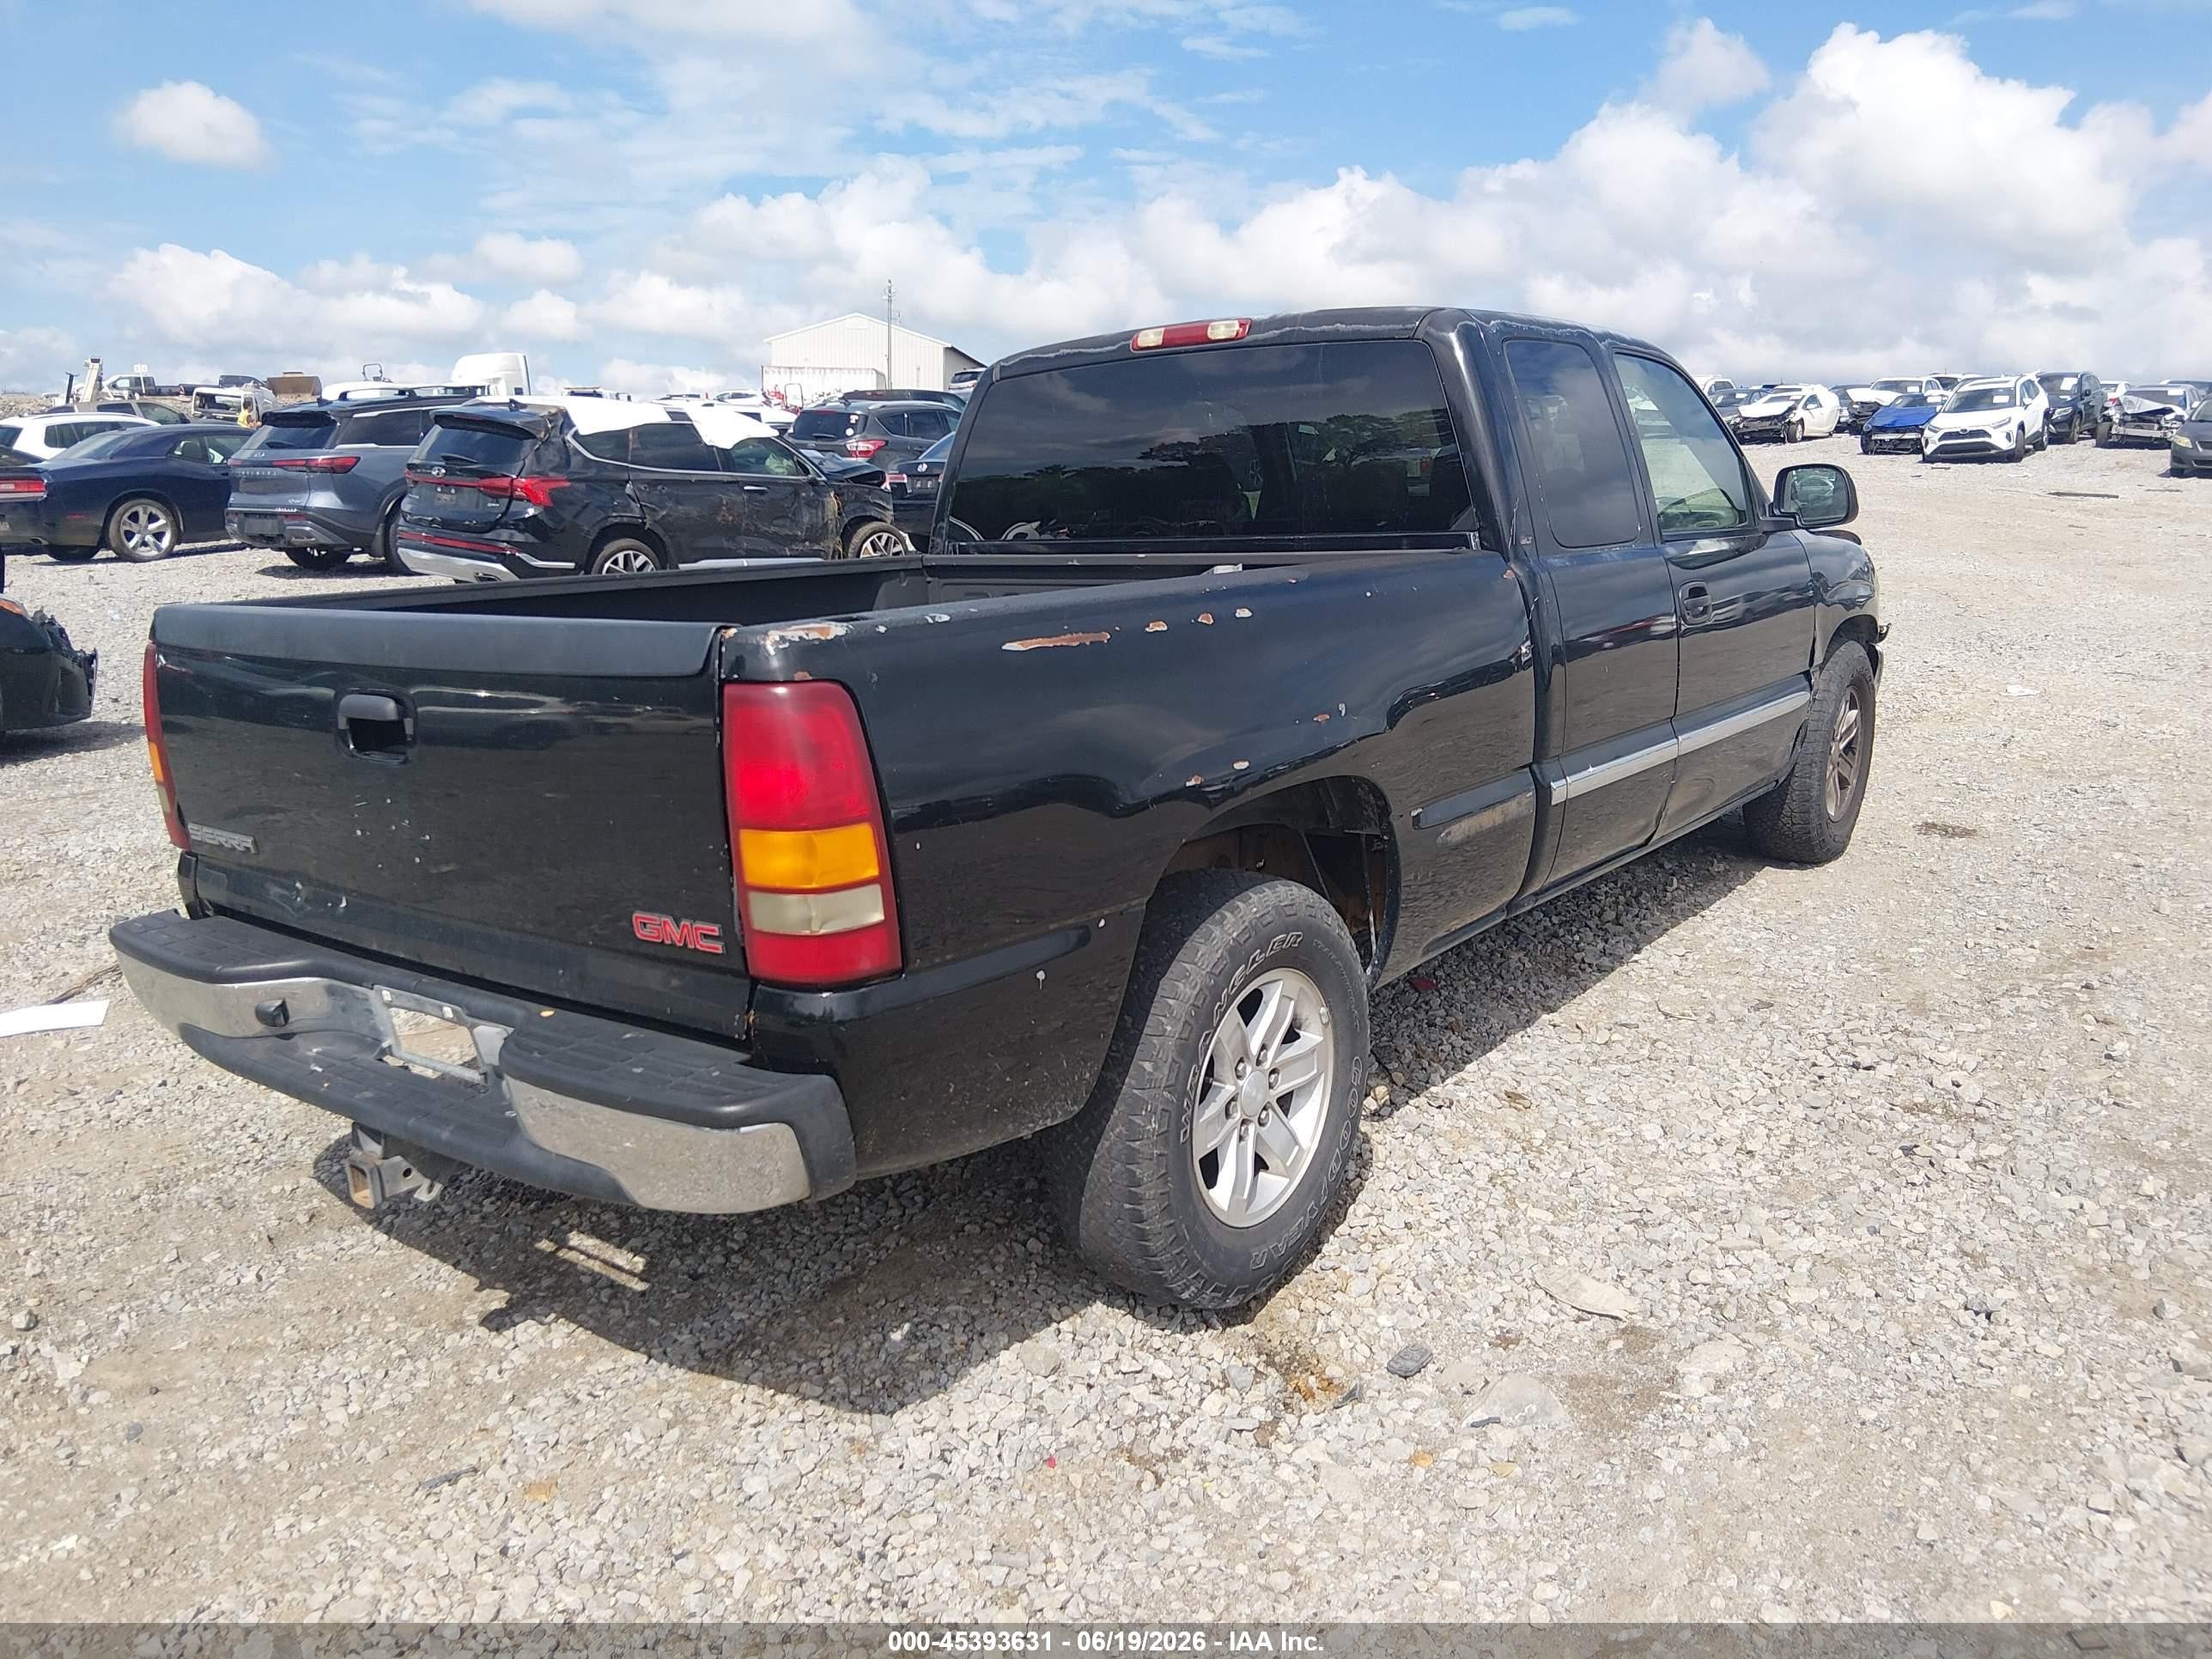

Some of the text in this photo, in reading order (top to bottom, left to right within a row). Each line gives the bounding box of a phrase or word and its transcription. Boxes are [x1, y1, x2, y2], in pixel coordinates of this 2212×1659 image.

[187, 822, 258, 854] SIERRA
[632, 910, 726, 955] GMC
[1250, 1056, 1363, 1270] GOODYEAR
